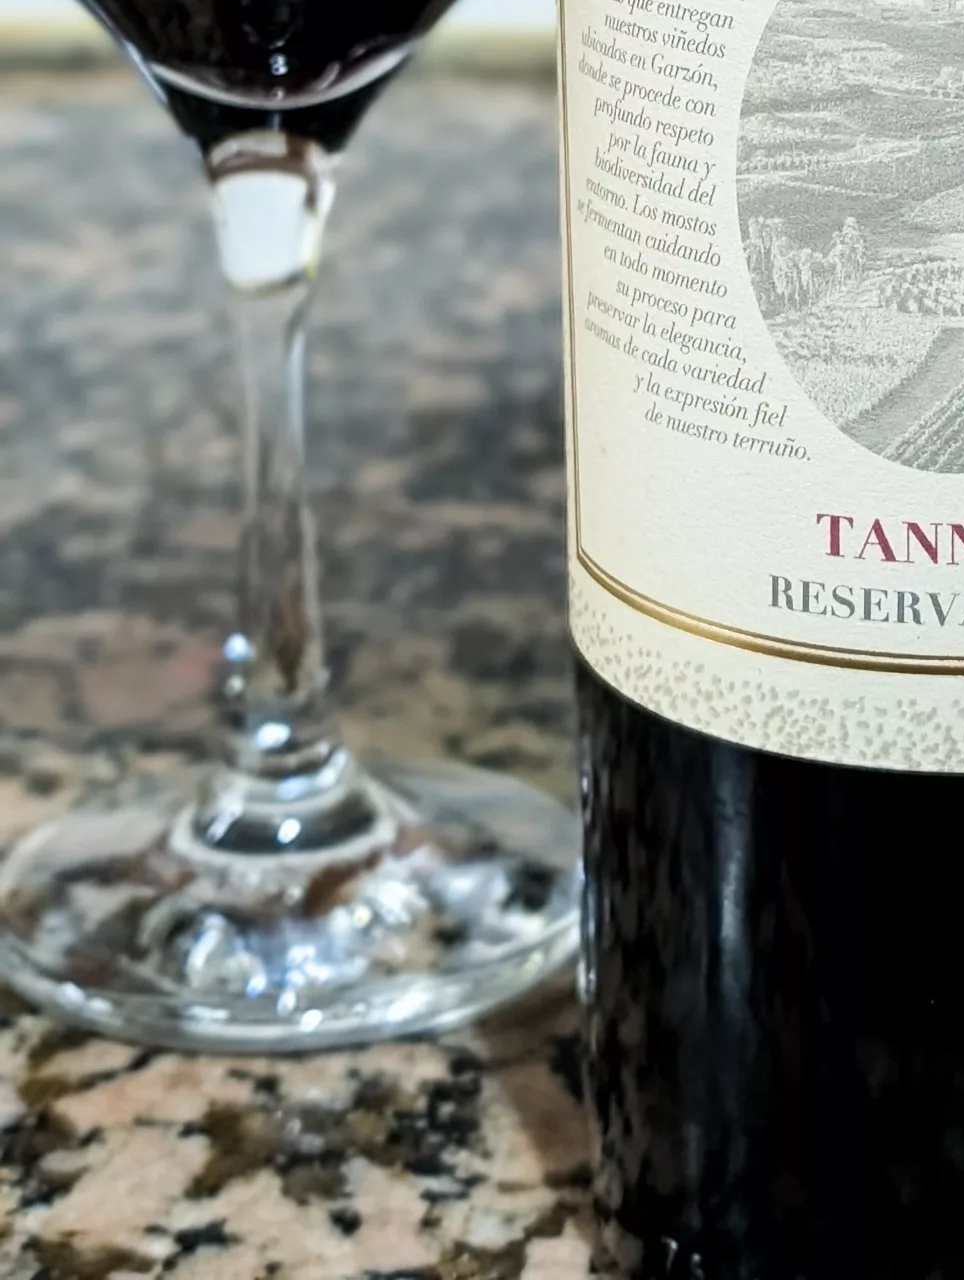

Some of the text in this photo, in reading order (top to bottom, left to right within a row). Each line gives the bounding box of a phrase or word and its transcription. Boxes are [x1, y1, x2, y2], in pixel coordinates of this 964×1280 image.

[605, 13, 726, 59] nuestros viñedos
[657, 1, 735, 33] entregan
[579, 53, 716, 117] donde se procede con
[582, 26, 718, 91] ubicados en Garzón,
[594, 96, 714, 147] profundo respeto
[595, 146, 717, 207] biodiversidad del
[607, 132, 716, 181] por la fauna y
[577, 196, 721, 267] se fermentan cuidando
[586, 176, 717, 236] entorno. Los mostos
[604, 245, 727, 298] en todo momento
[587, 291, 747, 364] preservar la elegancia,
[616, 279, 736, 331] su proceso para
[623, 334, 639, 359] de
[642, 349, 678, 373] cada
[683, 364, 767, 395] variedad
[633, 372, 787, 428] y la expresión fiel
[645, 401, 811, 461] de nuestro terruño.
